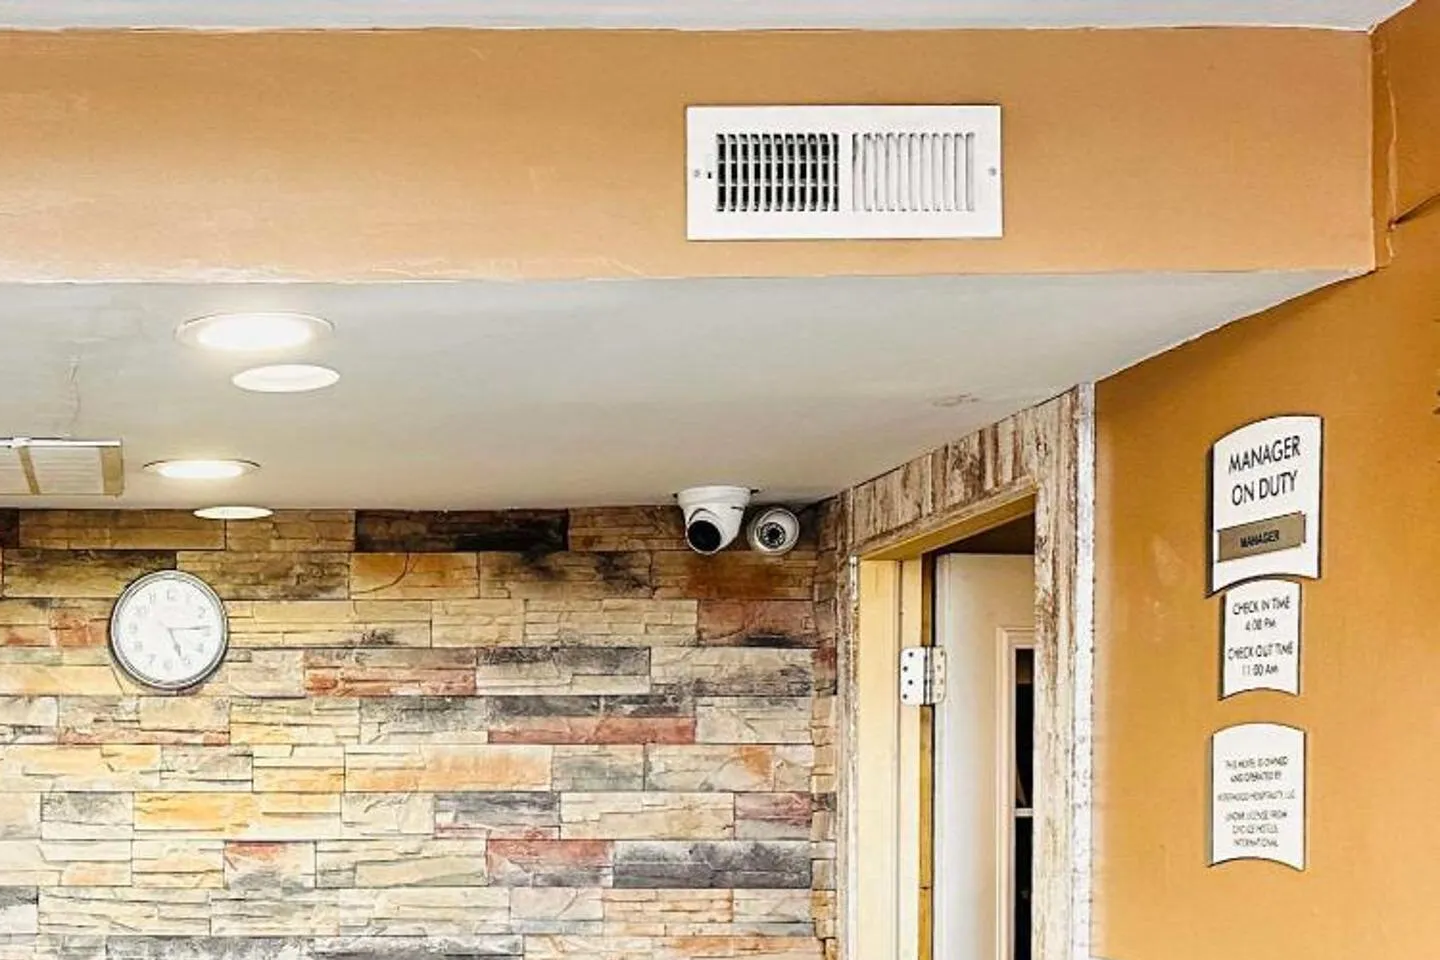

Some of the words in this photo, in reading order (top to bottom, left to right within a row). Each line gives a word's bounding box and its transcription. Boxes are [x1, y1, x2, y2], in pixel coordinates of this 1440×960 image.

[1228, 435, 1301, 474] MANAGER
[1231, 481, 1255, 506] ON
[1259, 470, 1299, 500] DUTY
[1240, 529, 1280, 548] MANAGER
[1232, 600, 1259, 615] CHECK
[1272, 596, 1290, 610] TIME
[1228, 646, 1254, 661] CHECK
